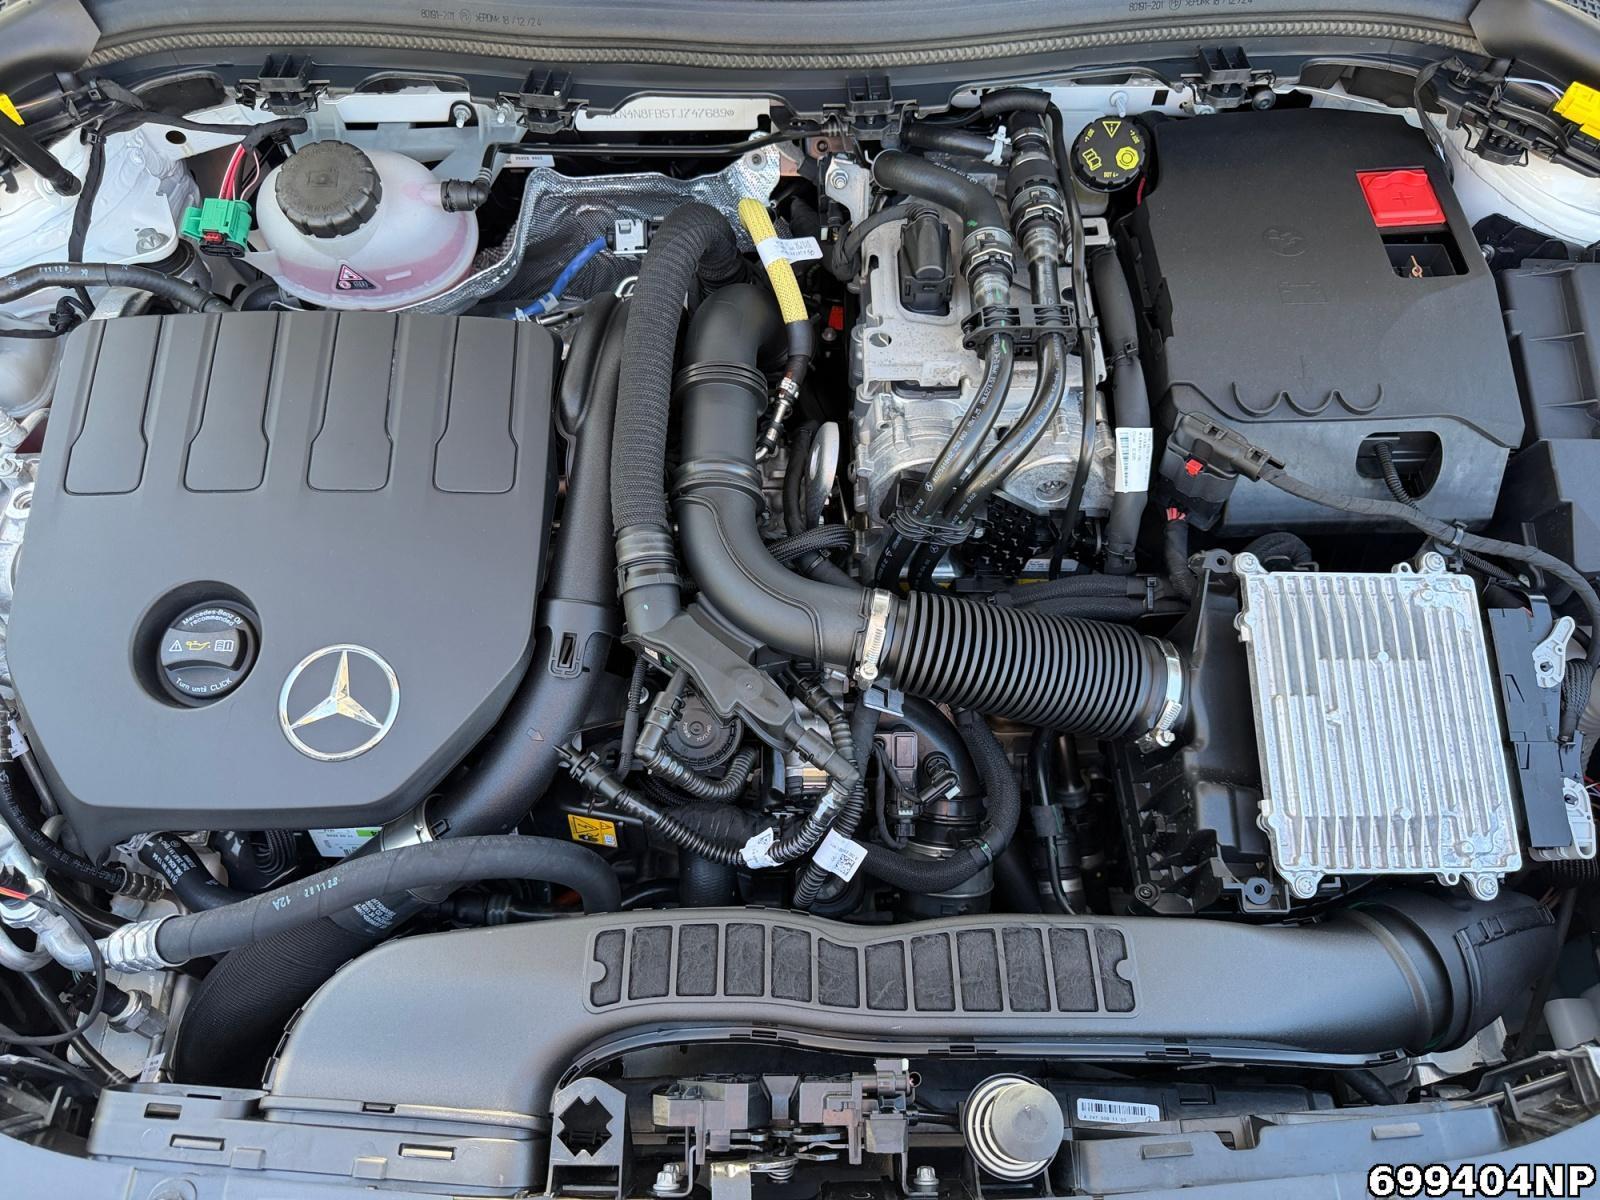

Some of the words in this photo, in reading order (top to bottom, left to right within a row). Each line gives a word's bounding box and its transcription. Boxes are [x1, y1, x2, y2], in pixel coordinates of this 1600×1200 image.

[182, 608, 235, 626] Mercedes-Benz
[189, 614, 235, 627] recommended
[176, 676, 190, 691] Turn
[191, 685, 208, 693] until
[210, 676, 233, 692] CLICK
